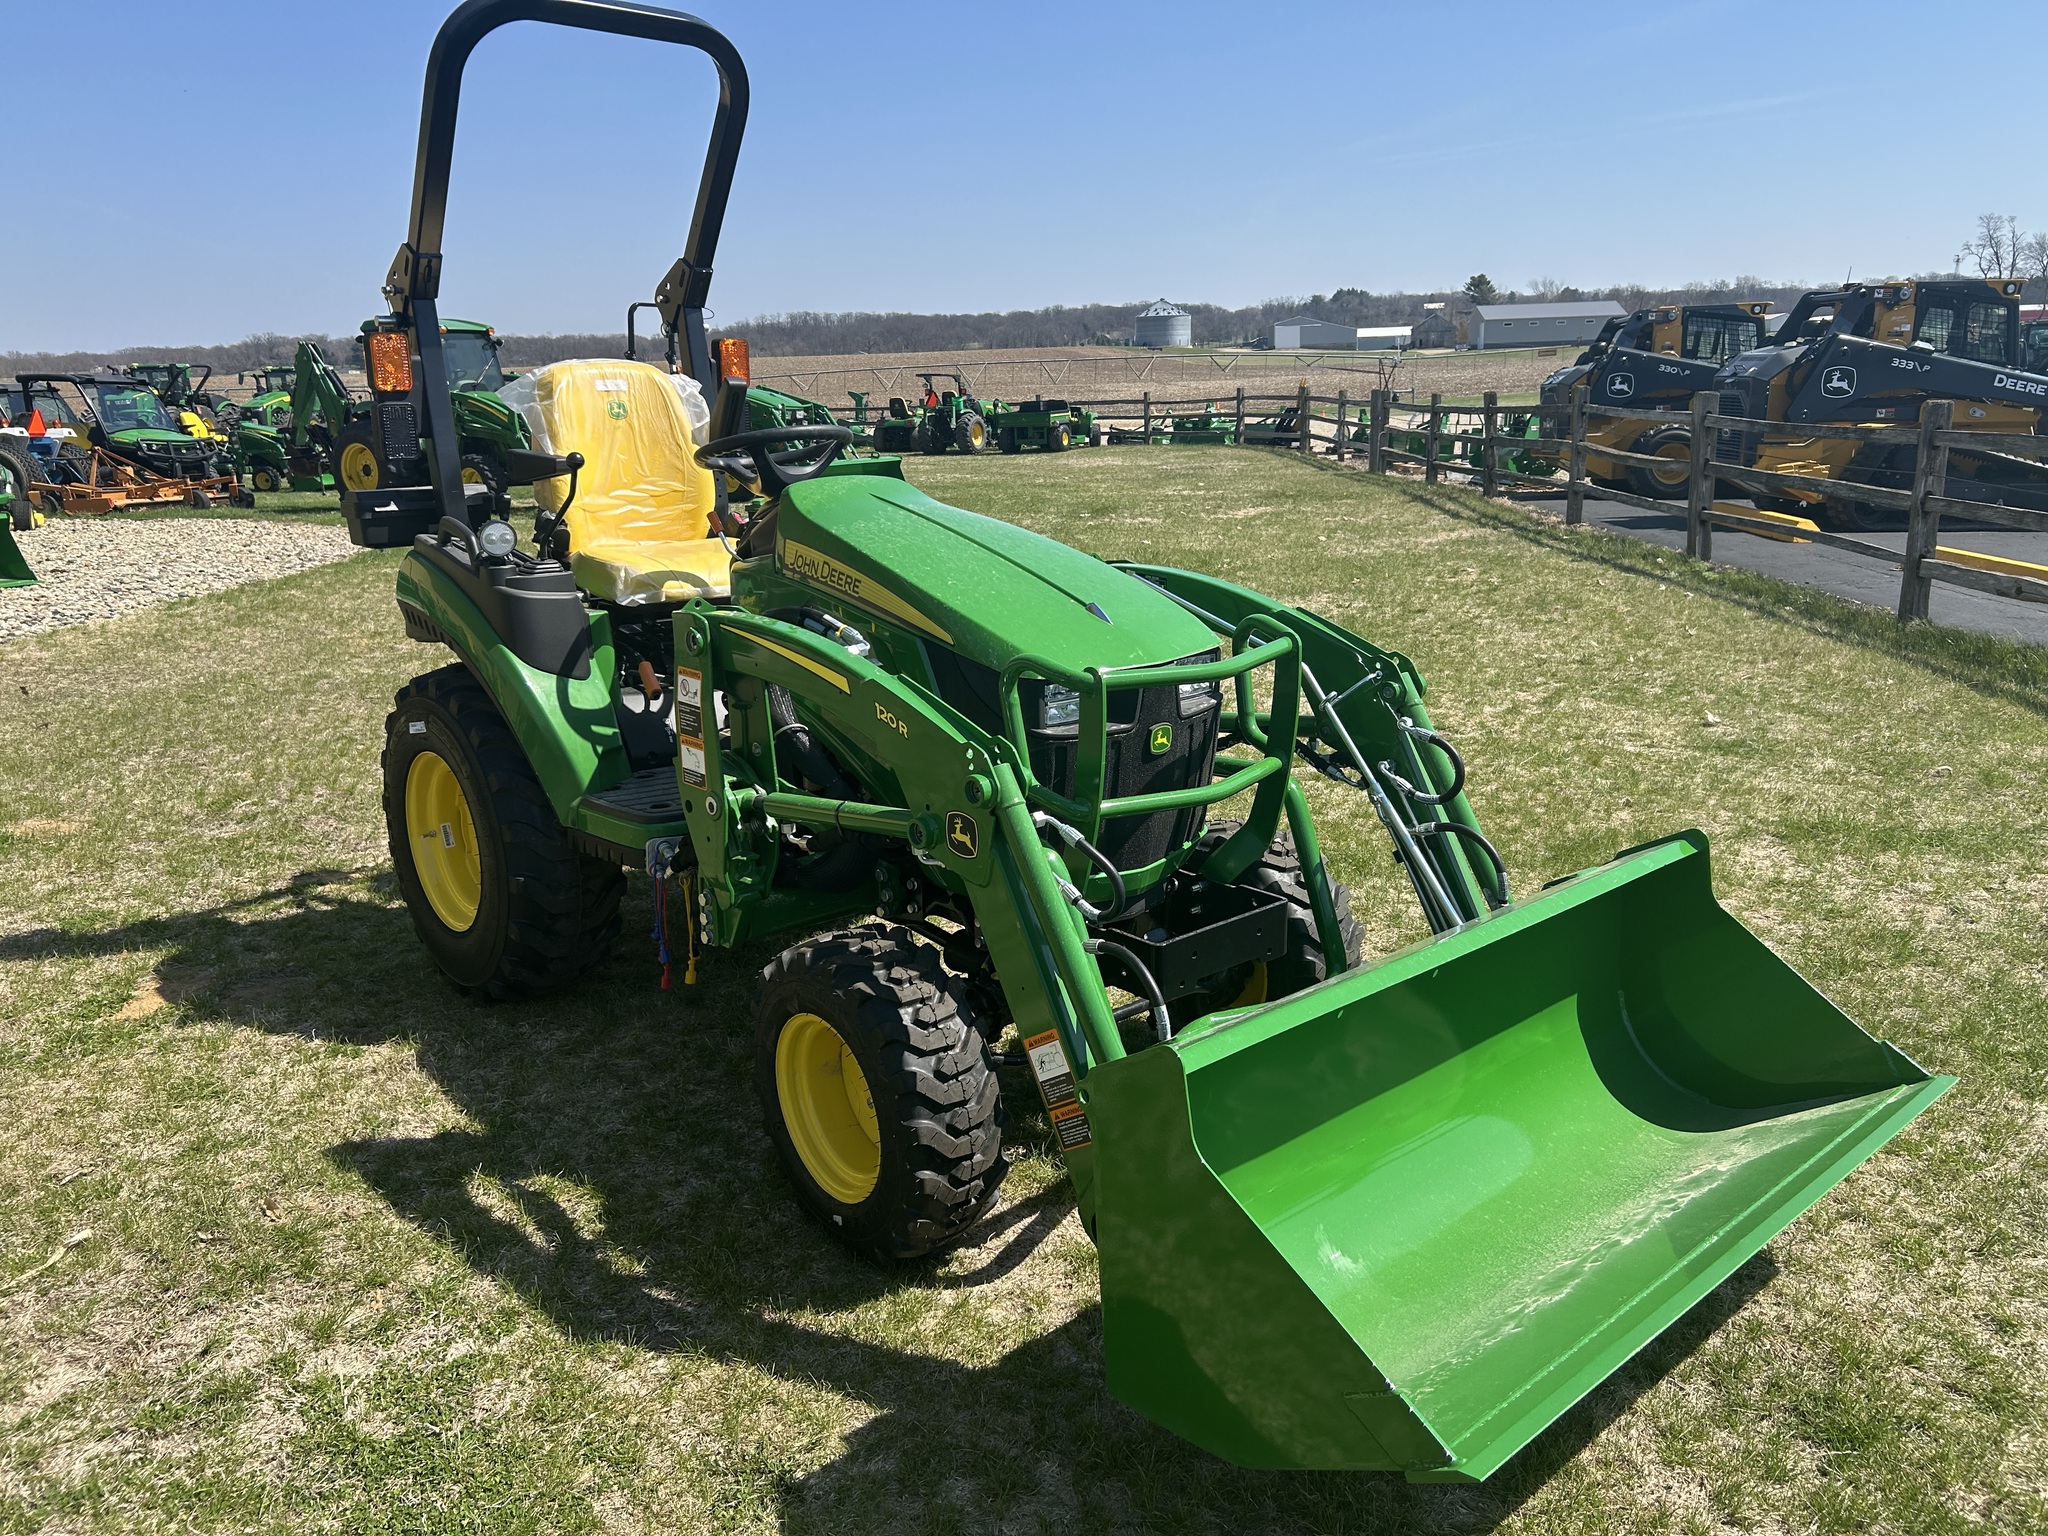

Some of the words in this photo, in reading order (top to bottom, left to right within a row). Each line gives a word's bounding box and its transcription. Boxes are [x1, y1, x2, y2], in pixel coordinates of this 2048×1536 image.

[1993, 373, 2048, 396] DEERE
[789, 549, 820, 579] JOHN
[820, 560, 862, 596] DEERE
[682, 669, 701, 679] WARNING
[684, 739, 703, 750] WARNING
[1033, 1032, 1055, 1046] WARNING
[1060, 1105, 1083, 1118] WARNING
